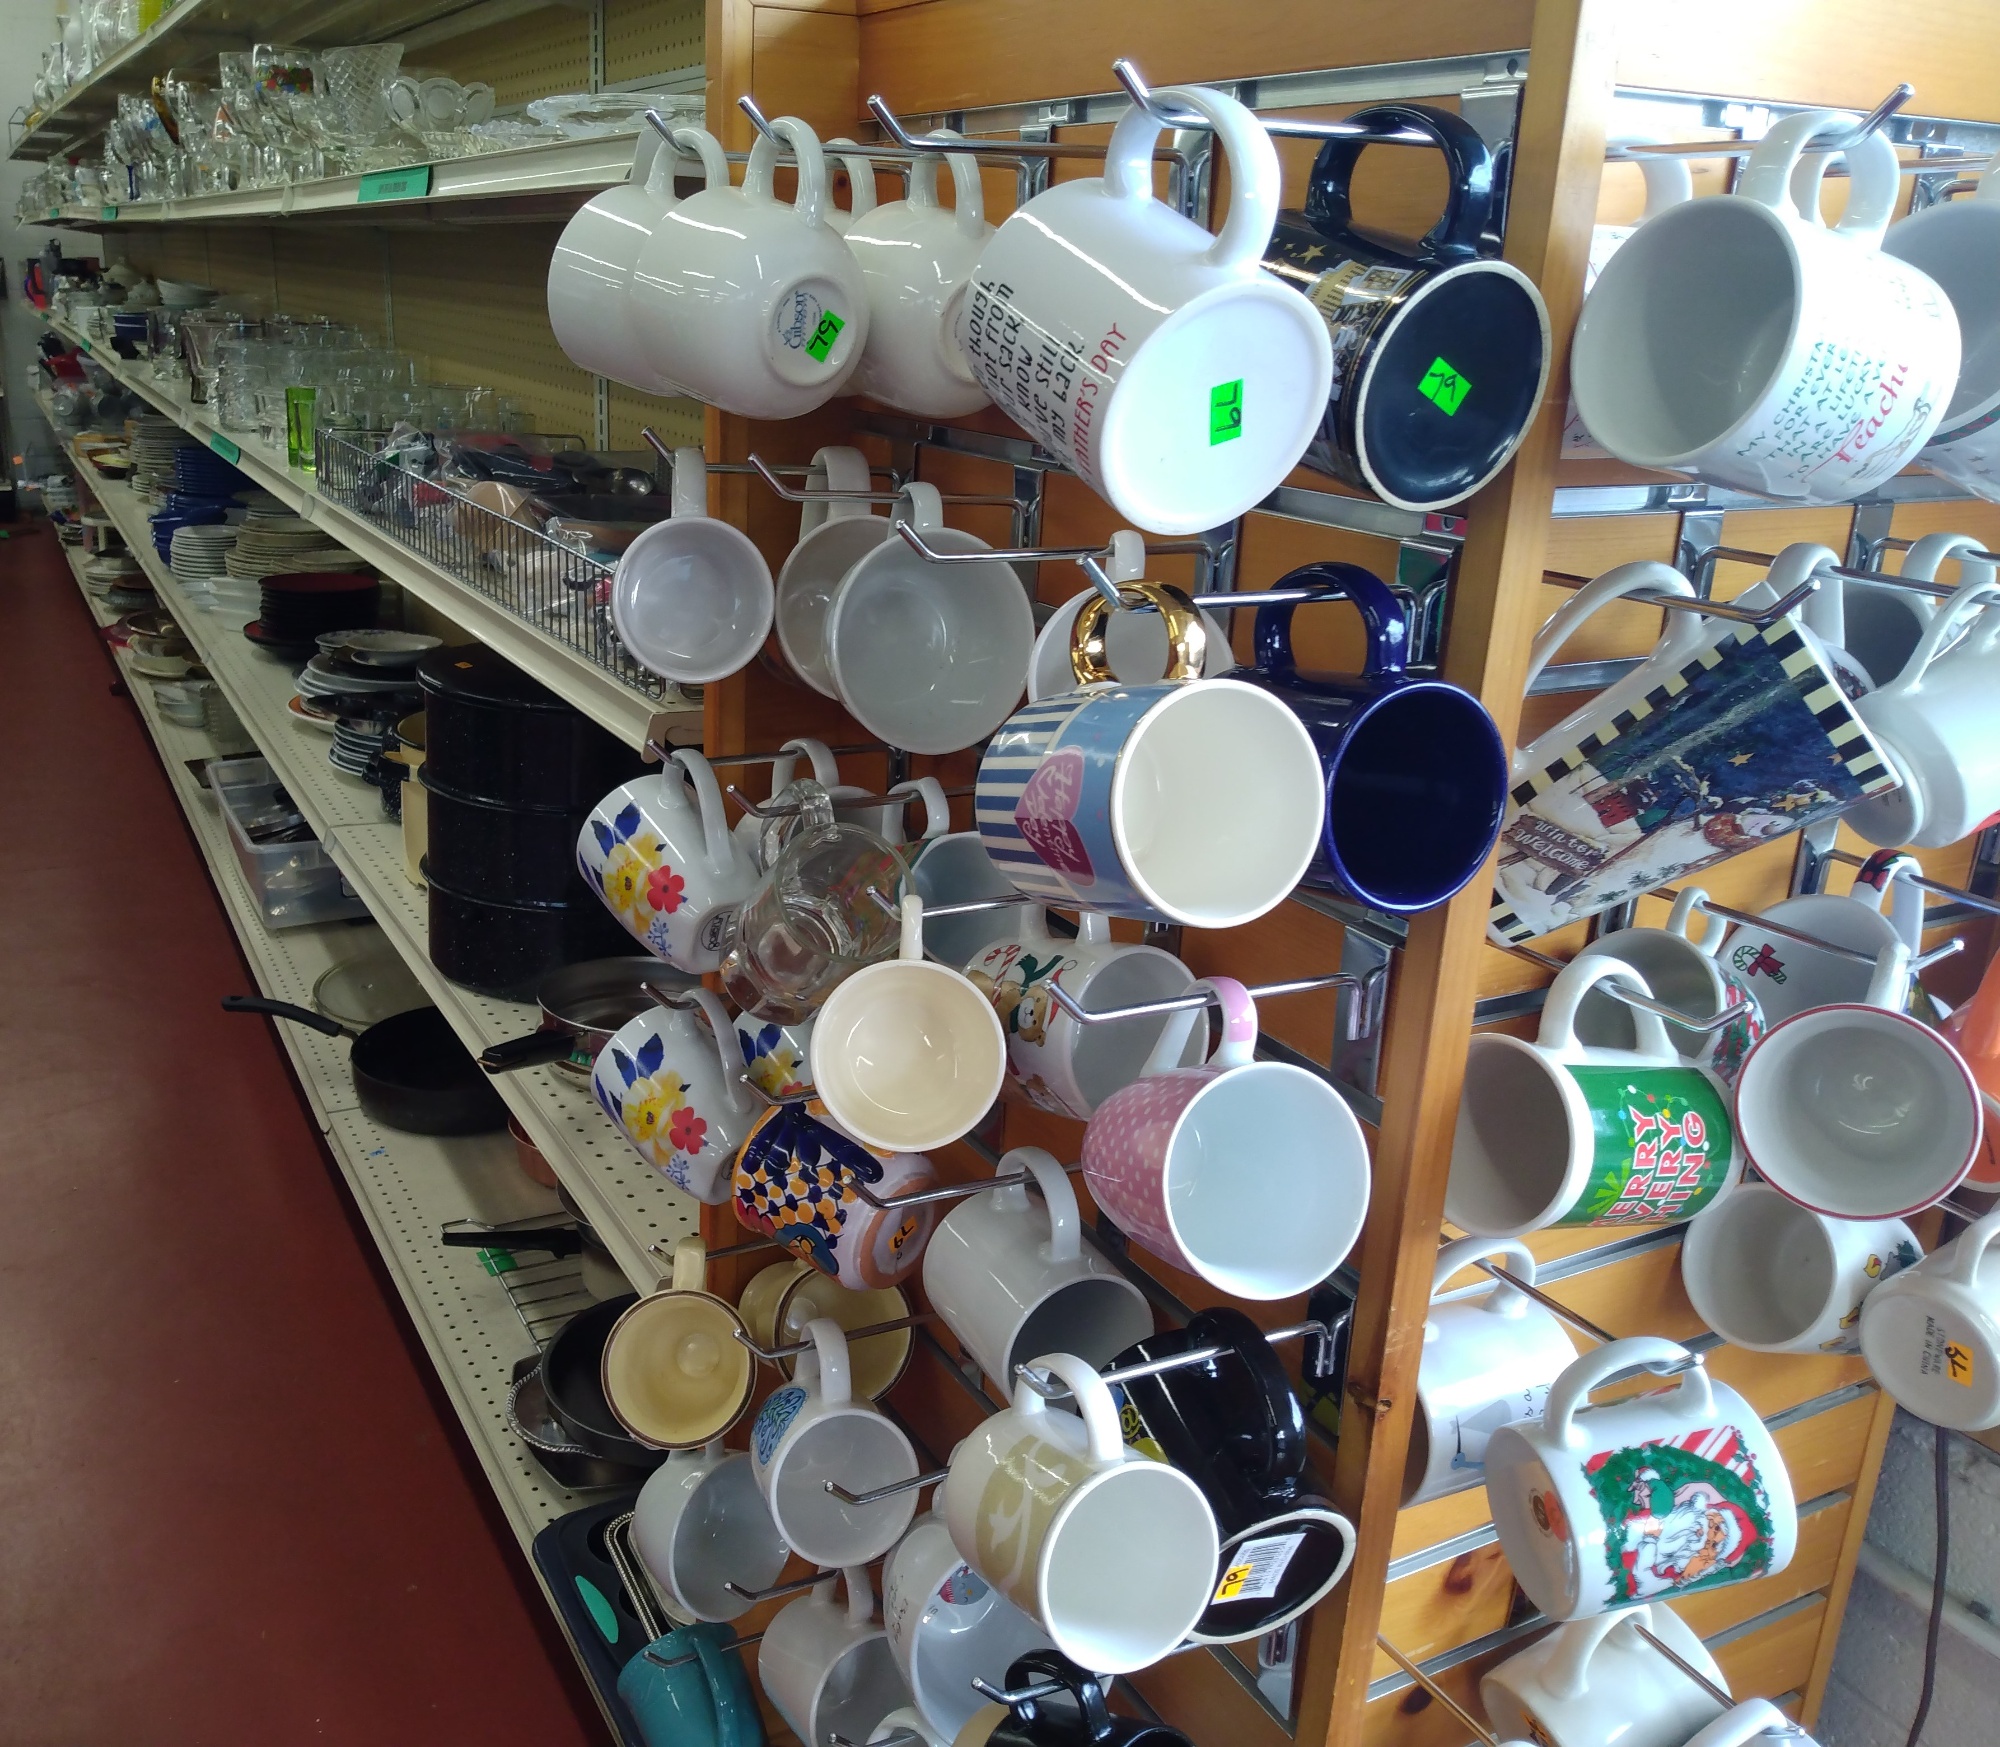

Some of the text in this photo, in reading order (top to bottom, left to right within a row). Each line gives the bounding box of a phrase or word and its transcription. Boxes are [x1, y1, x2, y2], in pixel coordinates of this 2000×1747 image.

[968, 280, 995, 358] though
[985, 283, 1014, 345] from
[1035, 335, 1064, 389] still
[1052, 341, 1085, 404] back.
[1090, 321, 1128, 374] DAY
[1016, 345, 1034, 413] know
[1428, 371, 1460, 402] 79
[1800, 356, 1872, 463] ARE LUCKY
[1736, 430, 1767, 457] MY
[1763, 414, 1812, 460] THAT
[1816, 380, 1833, 412] AT
[1774, 404, 1808, 440] FOR
[1786, 439, 1807, 458] IN
[1814, 420, 1828, 435] A
[1816, 410, 1862, 460] HAVE
[1614, 1112, 1683, 1224] VERY
[1640, 1110, 1706, 1222] HING
